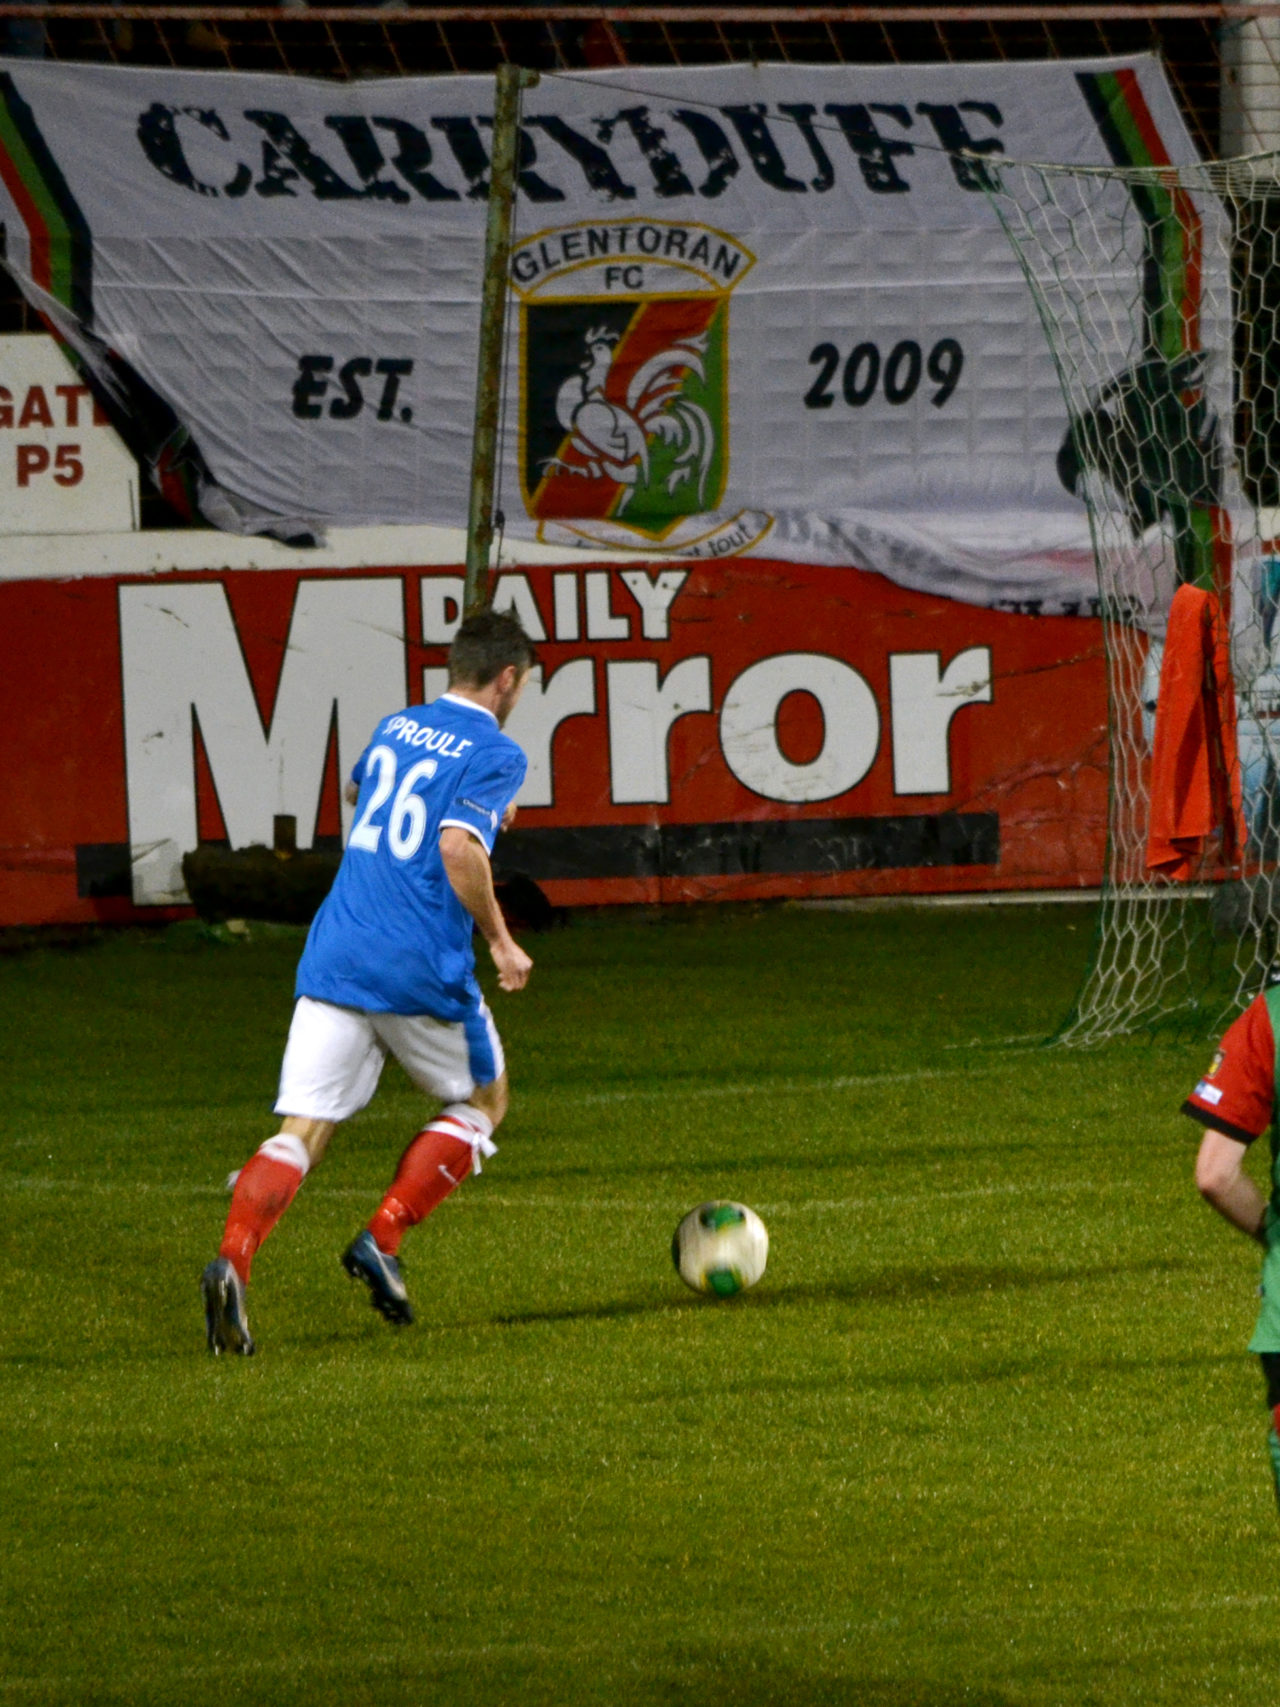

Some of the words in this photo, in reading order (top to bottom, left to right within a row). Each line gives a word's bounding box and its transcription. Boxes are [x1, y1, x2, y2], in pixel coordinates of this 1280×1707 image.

[136, 99, 1006, 203] CARRYDUFF
[511, 225, 742, 284] GLENTORAN
[604, 265, 644, 290] FC
[291, 353, 415, 424] EST.
[803, 338, 965, 410] 2009
[16, 444, 85, 488] P5
[420, 569, 690, 646] DAILY
[117, 577, 993, 906] Mrror
[349, 744, 438, 860] 26
